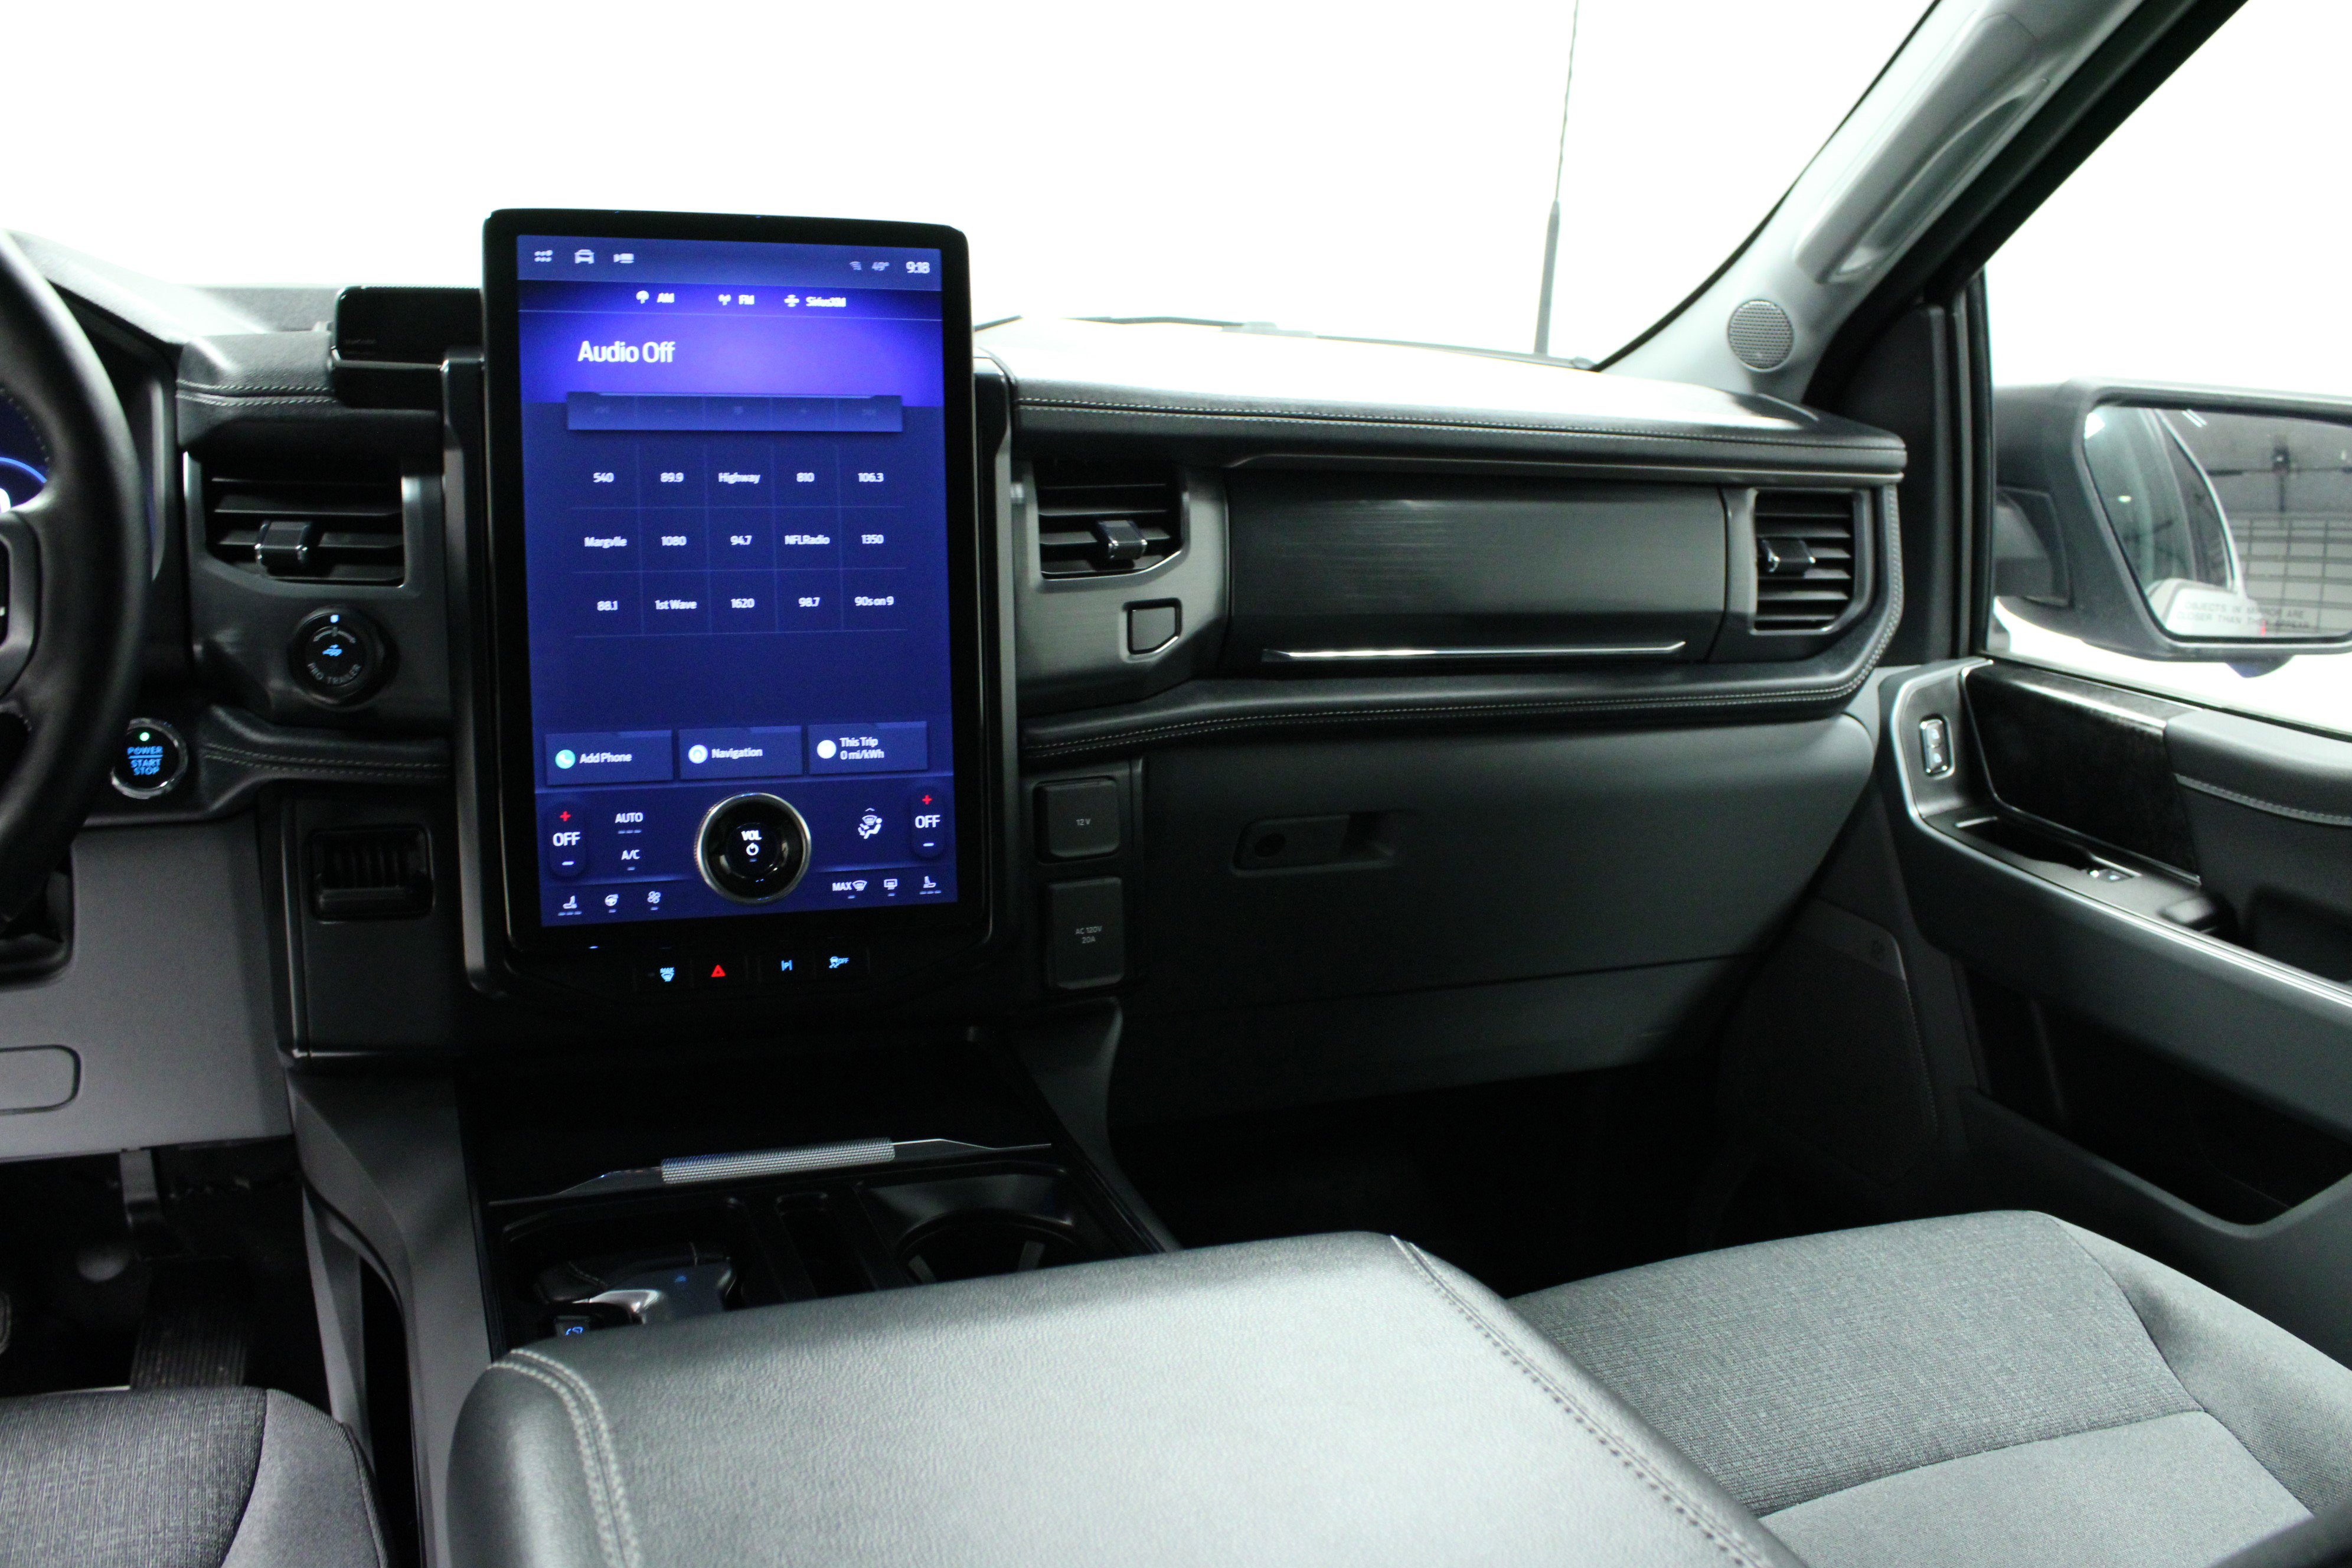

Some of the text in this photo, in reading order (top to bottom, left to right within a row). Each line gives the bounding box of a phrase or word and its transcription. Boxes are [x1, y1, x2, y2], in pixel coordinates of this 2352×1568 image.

[906, 261, 930, 274] 9:18
[656, 292, 675, 303] AM
[738, 294, 754, 305] FM
[806, 296, 847, 308] SiriusXM
[577, 340, 676, 363] Audio Off
[593, 472, 614, 483] 540
[660, 472, 684, 483] 89.9
[718, 472, 760, 484] Highway
[796, 472, 815, 482] 810
[858, 472, 884, 482] 106.3
[730, 535, 752, 545] 94.7
[861, 534, 884, 544] 1350
[597, 600, 618, 611] 88.1
[655, 599, 697, 610] 1st Wave
[731, 598, 755, 609] 1620
[798, 597, 820, 607] 98.7
[2185, 601, 2227, 612] OBJECTS
[307, 662, 361, 685] PRO TRAILER
[839, 736, 878, 747] This Trip
[127, 746, 163, 756] POWER
[711, 747, 763, 760] Navigation
[840, 749, 885, 760] 0 mi/kWh
[130, 759, 162, 768] START
[579, 752, 632, 764] Add Phone
[133, 766, 160, 776] STOP
[615, 812, 643, 824] AUTO
[915, 815, 941, 828] OFF
[553, 831, 581, 847] OFF
[741, 830, 762, 841] VOL
[621, 849, 641, 860] A/C
[832, 881, 852, 891] MAX
